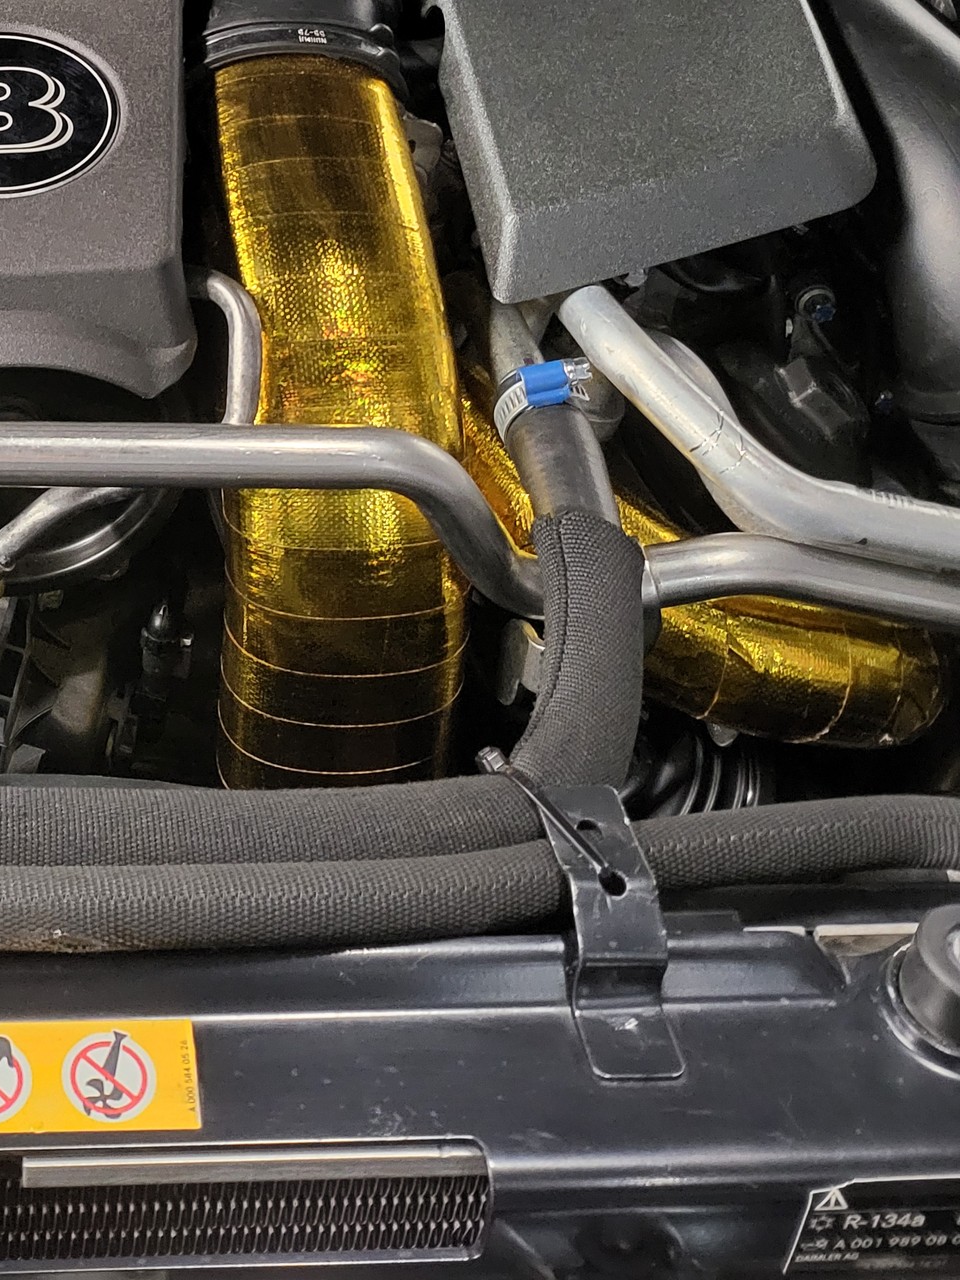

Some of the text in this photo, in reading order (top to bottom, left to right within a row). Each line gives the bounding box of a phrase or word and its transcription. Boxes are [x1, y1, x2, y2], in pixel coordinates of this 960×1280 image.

[843, 1213, 926, 1230] R-134a
[833, 1239, 846, 1250] A
[850, 1237, 883, 1250] 001
[889, 1235, 922, 1248] 989
